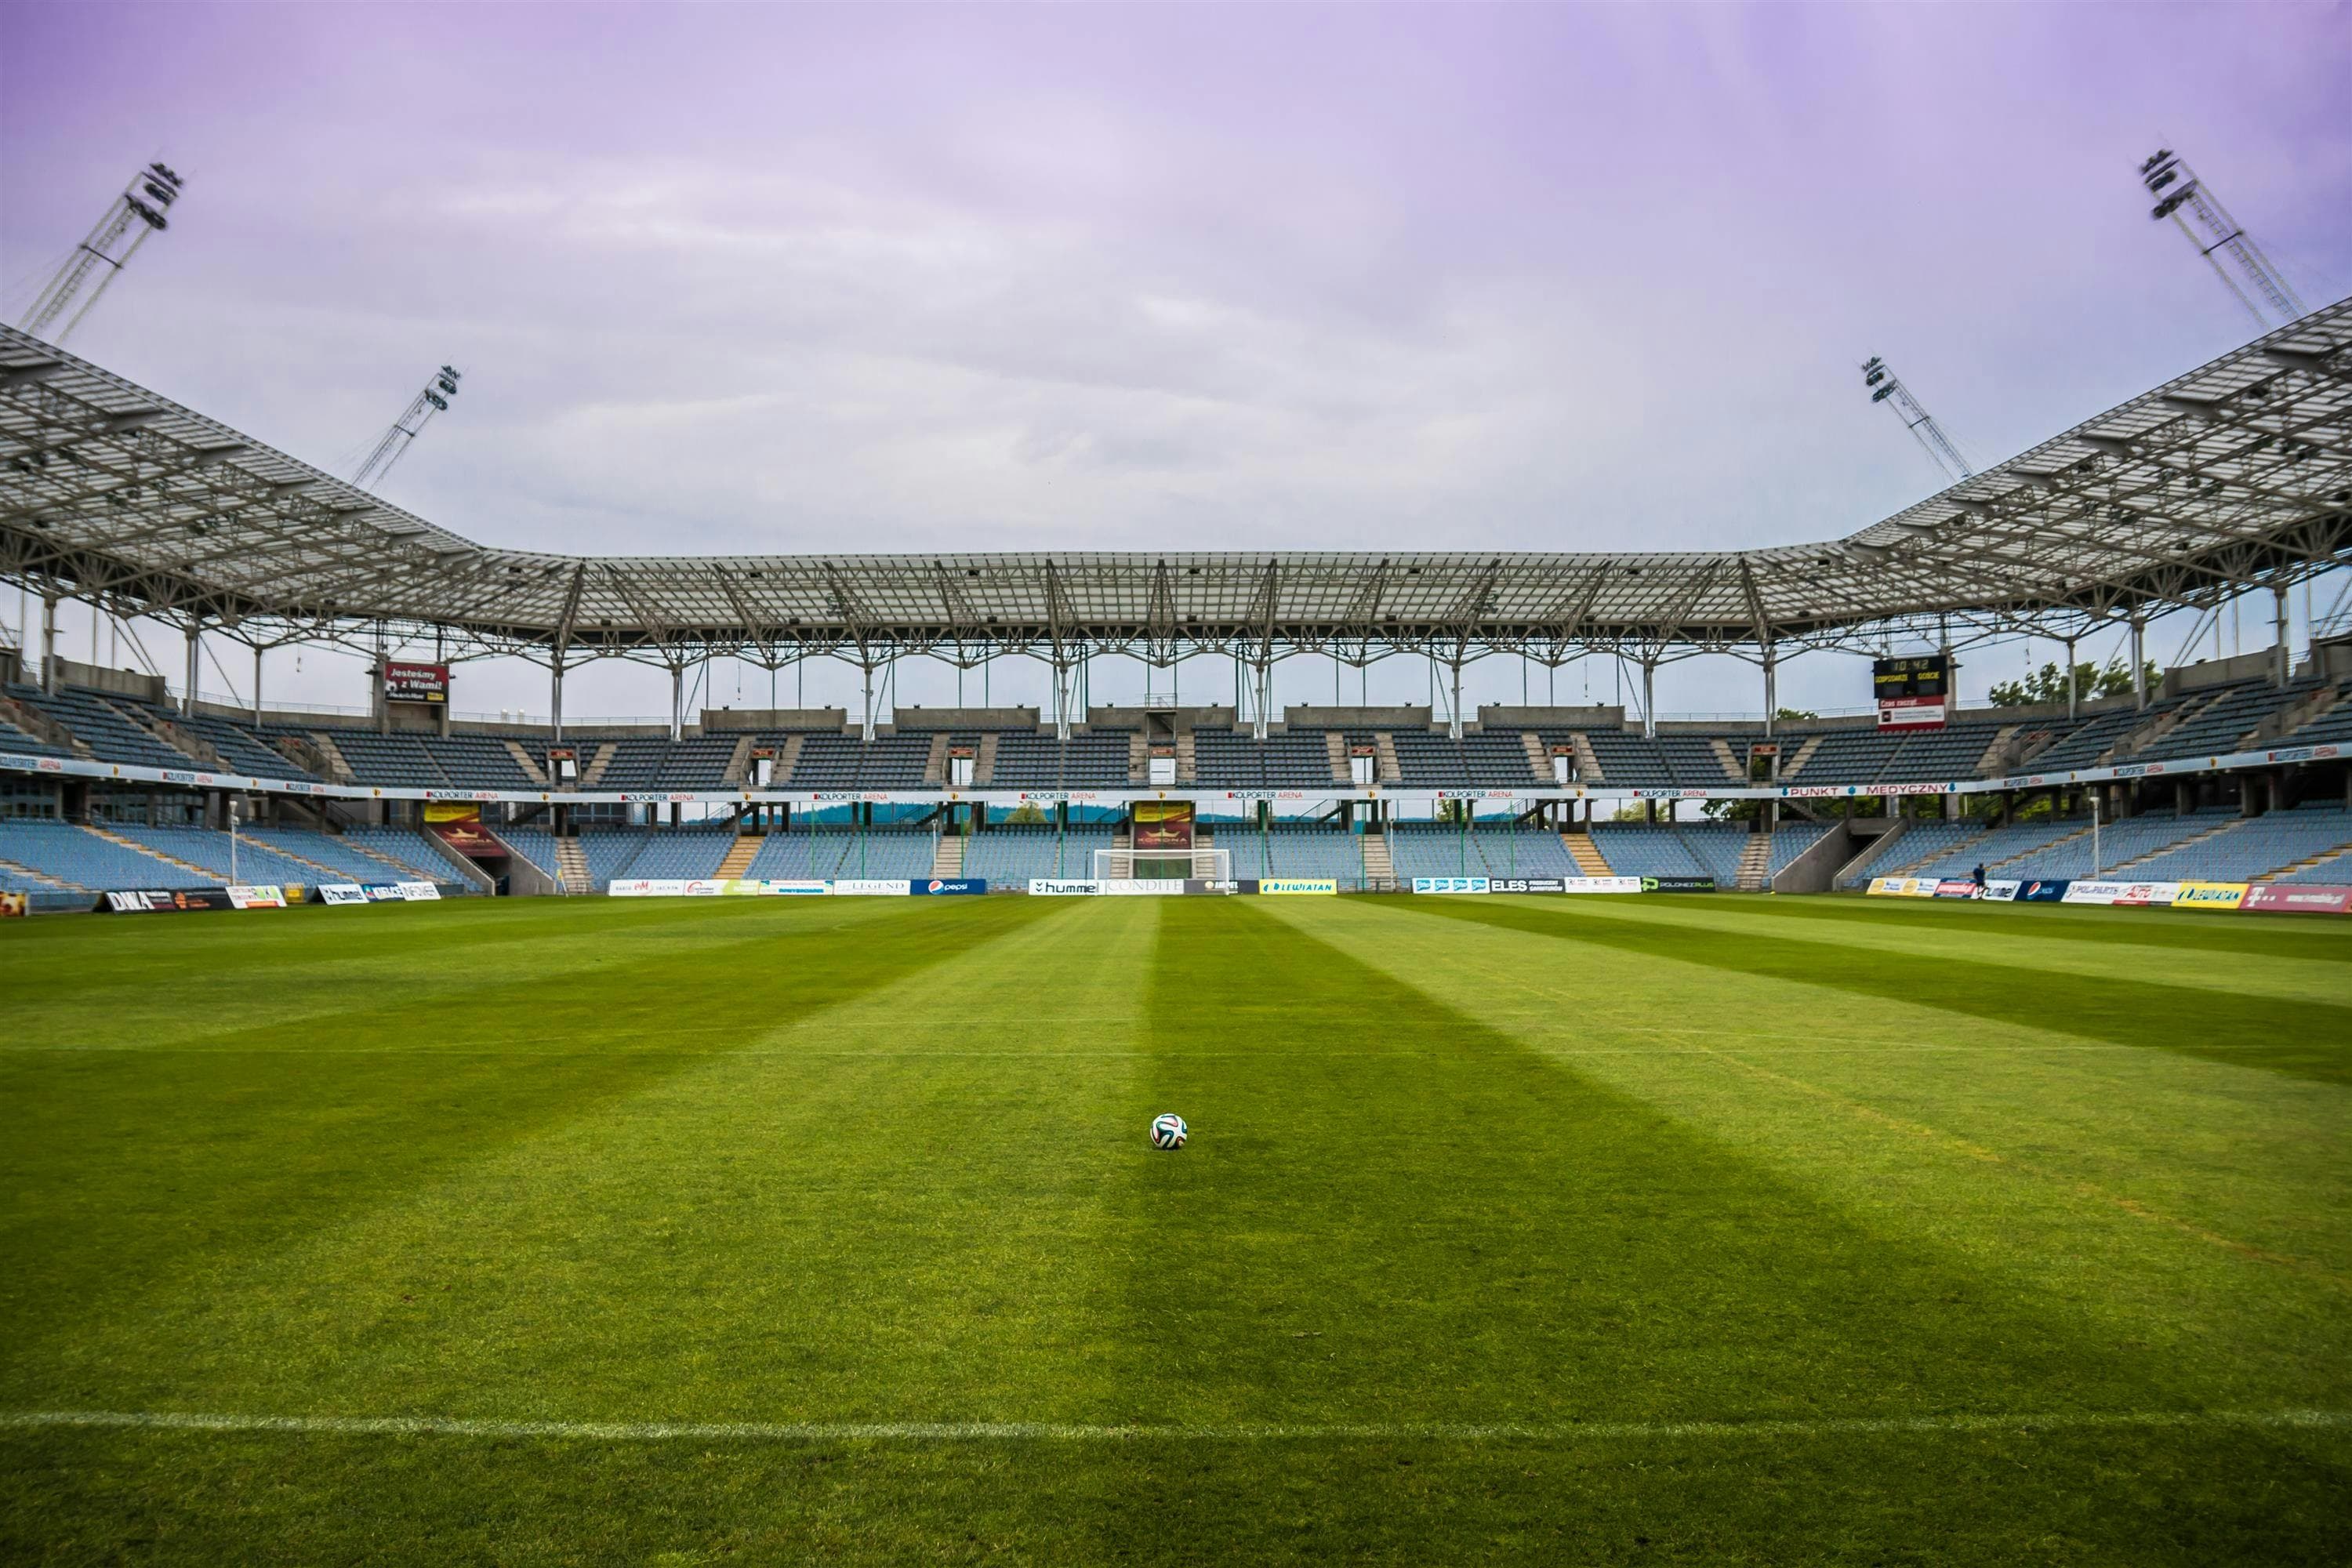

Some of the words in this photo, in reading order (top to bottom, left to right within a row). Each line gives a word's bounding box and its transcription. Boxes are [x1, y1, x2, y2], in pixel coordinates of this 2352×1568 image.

[430, 790, 473, 800] KOLPORTER
[475, 790, 499, 800] ARENA
[1791, 786, 1838, 797] PUNKT
[1866, 784, 1948, 795] MEDYCZNY
[944, 883, 968, 891] pepsi
[1046, 882, 1099, 893] hummel
[1491, 880, 1528, 892] ELES
